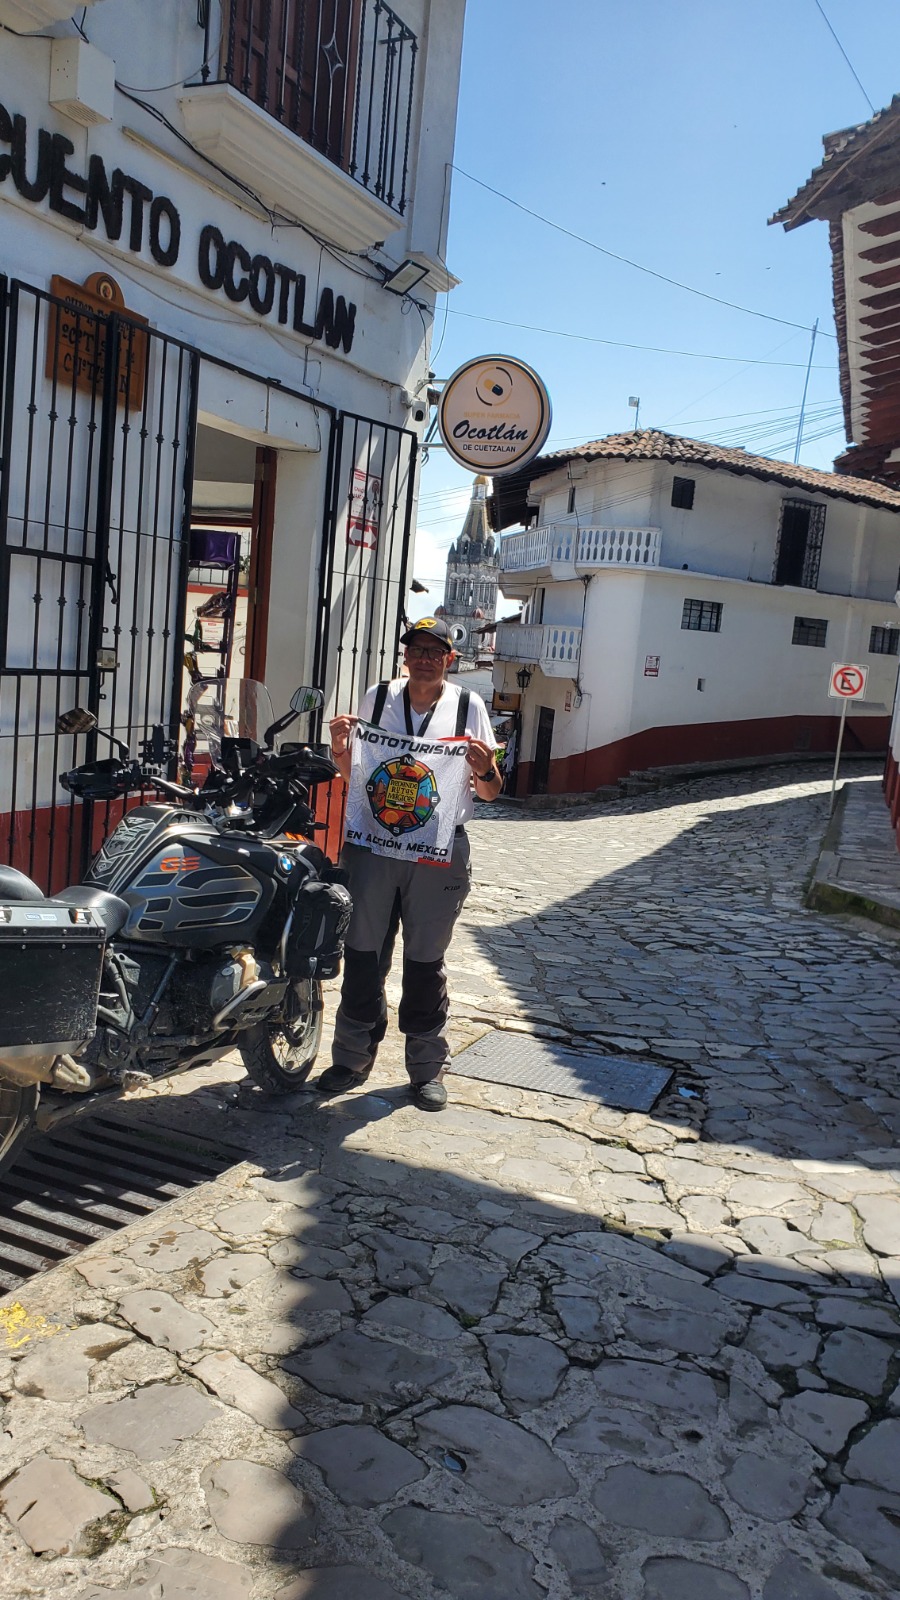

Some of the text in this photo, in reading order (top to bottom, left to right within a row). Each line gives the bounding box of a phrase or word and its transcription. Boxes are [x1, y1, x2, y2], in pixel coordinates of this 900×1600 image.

[199, 225, 356, 353] OCOTLAN
[452, 420, 528, 440] Ocotlán
[474, 444, 516, 452] CUETZALAN
[841, 672, 856, 690] E
[356, 727, 468, 757] MOTOTURISMO
[347, 830, 448, 857] EN ACCIÓN MÉXICO
[160, 856, 201, 872] GS
